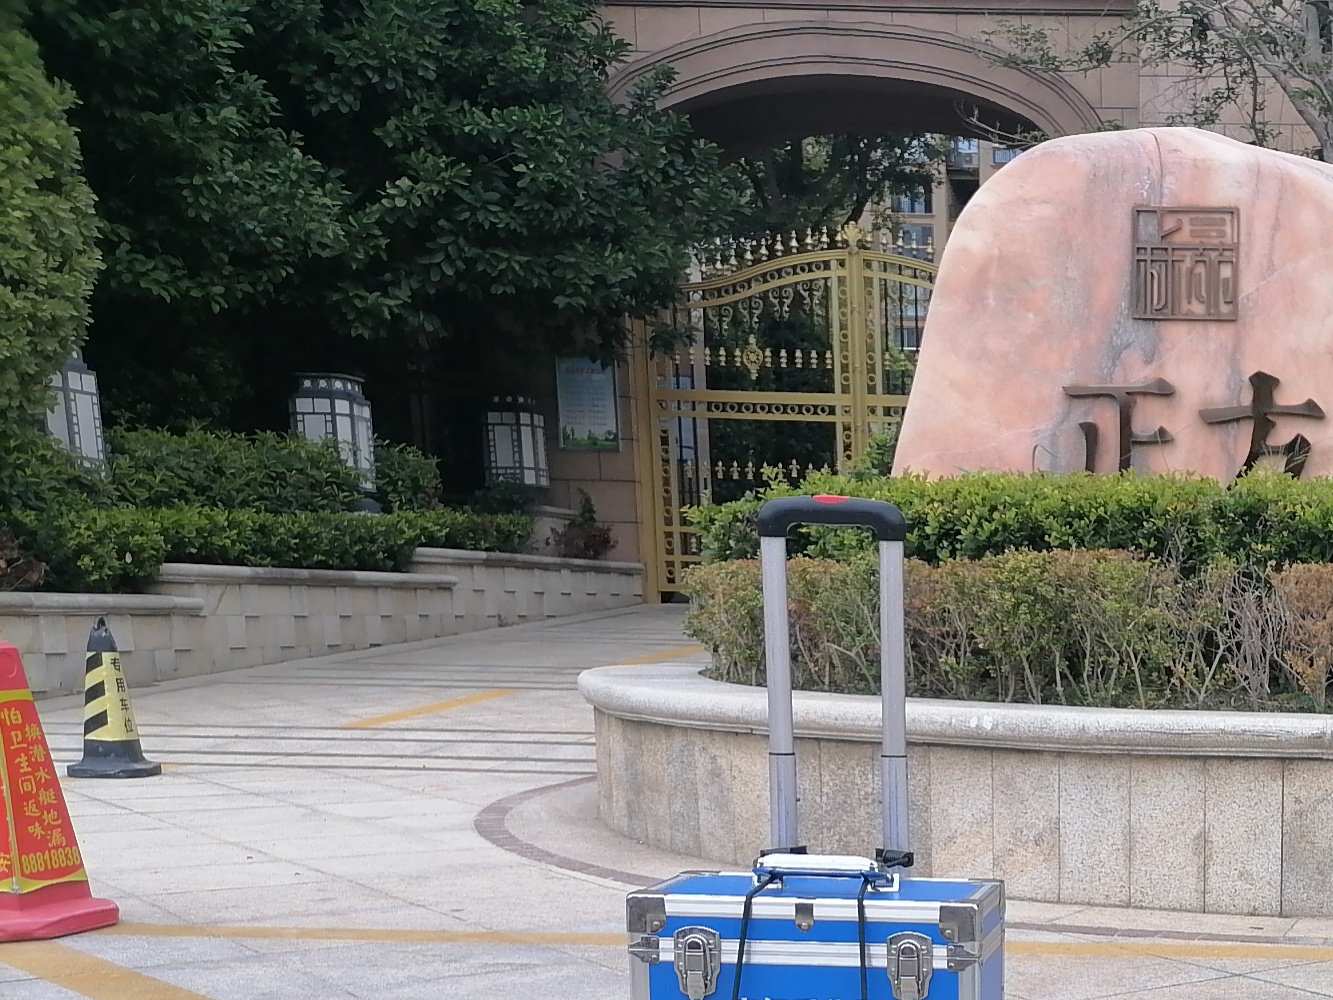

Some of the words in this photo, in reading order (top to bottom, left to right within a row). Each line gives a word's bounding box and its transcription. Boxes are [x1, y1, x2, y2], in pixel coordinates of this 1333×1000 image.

[110, 656, 134, 735] 专用车位
[1, 707, 46, 841] 怕卫生间返味
[25, 723, 67, 848] 换潜水艇地漏
[21, 846, 81, 875] 88818838
